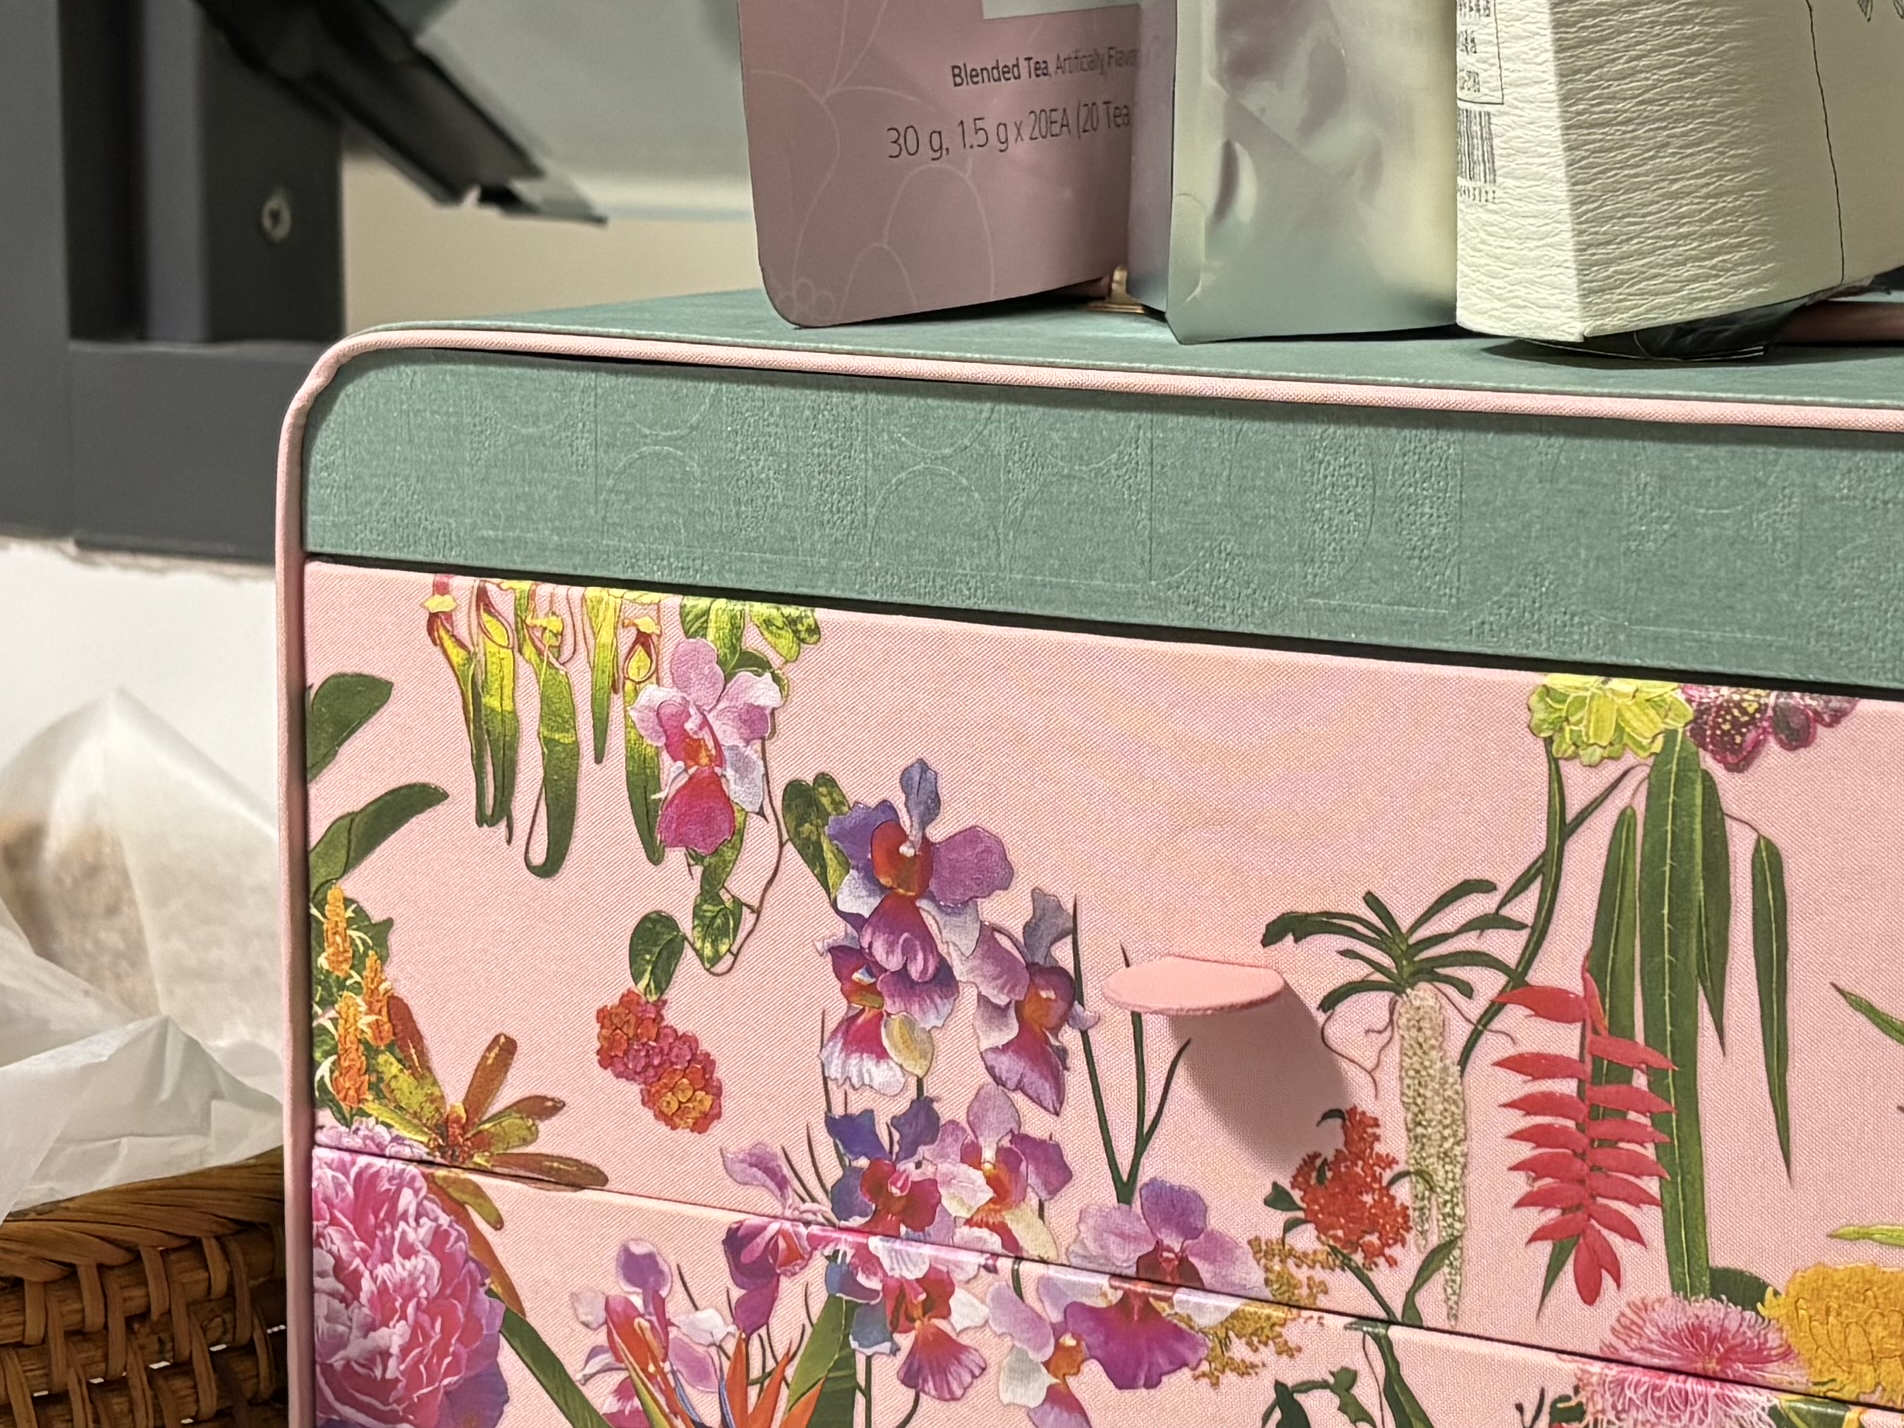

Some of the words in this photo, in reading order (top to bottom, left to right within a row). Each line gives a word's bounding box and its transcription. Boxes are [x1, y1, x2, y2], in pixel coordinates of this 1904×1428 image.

[951, 57, 1021, 87] Blended
[886, 125, 920, 159] 30
[929, 129, 950, 161] g,
[958, 117, 989, 151] 1.5
[996, 123, 1009, 153] g
[1028, 108, 1072, 141] 20EA
[1077, 100, 1099, 140] (20
[1102, 101, 1131, 130] Tea
